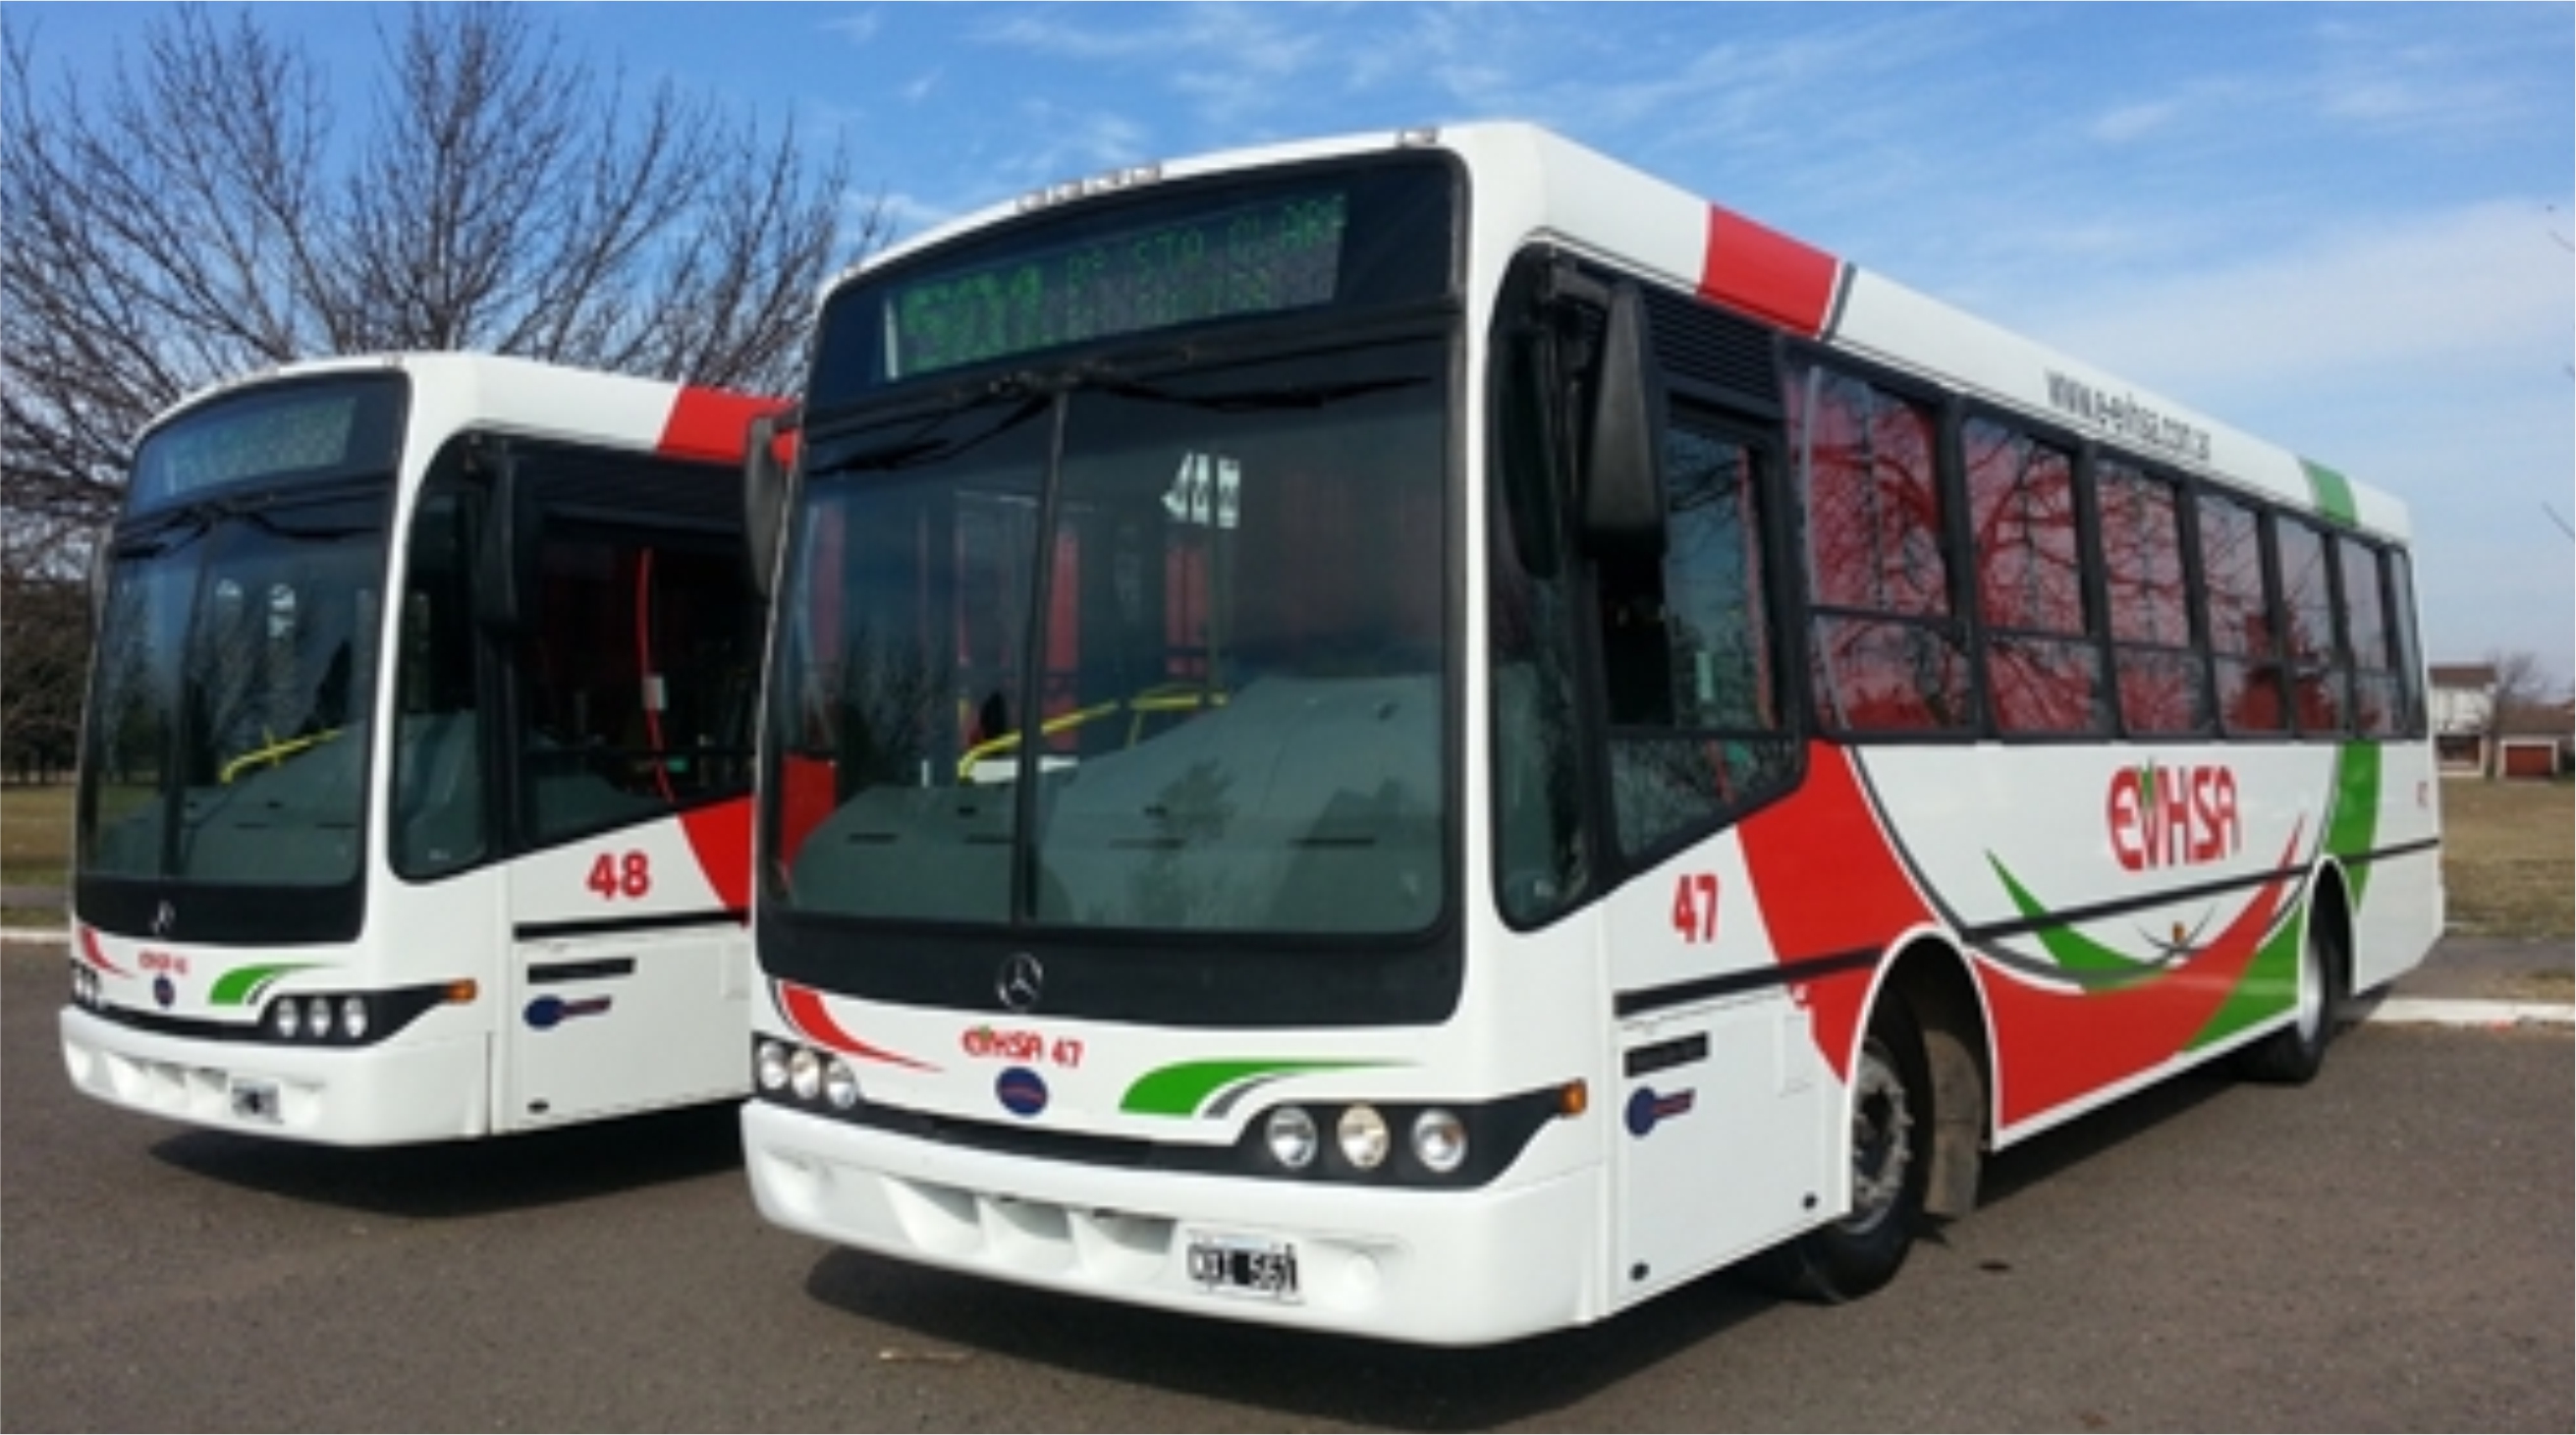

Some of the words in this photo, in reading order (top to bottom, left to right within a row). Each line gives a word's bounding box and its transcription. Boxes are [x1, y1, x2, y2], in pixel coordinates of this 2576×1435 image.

[587, 852, 650, 900] 48
[1673, 872, 1719, 943] 47
[1051, 1037, 1083, 1068] 47
